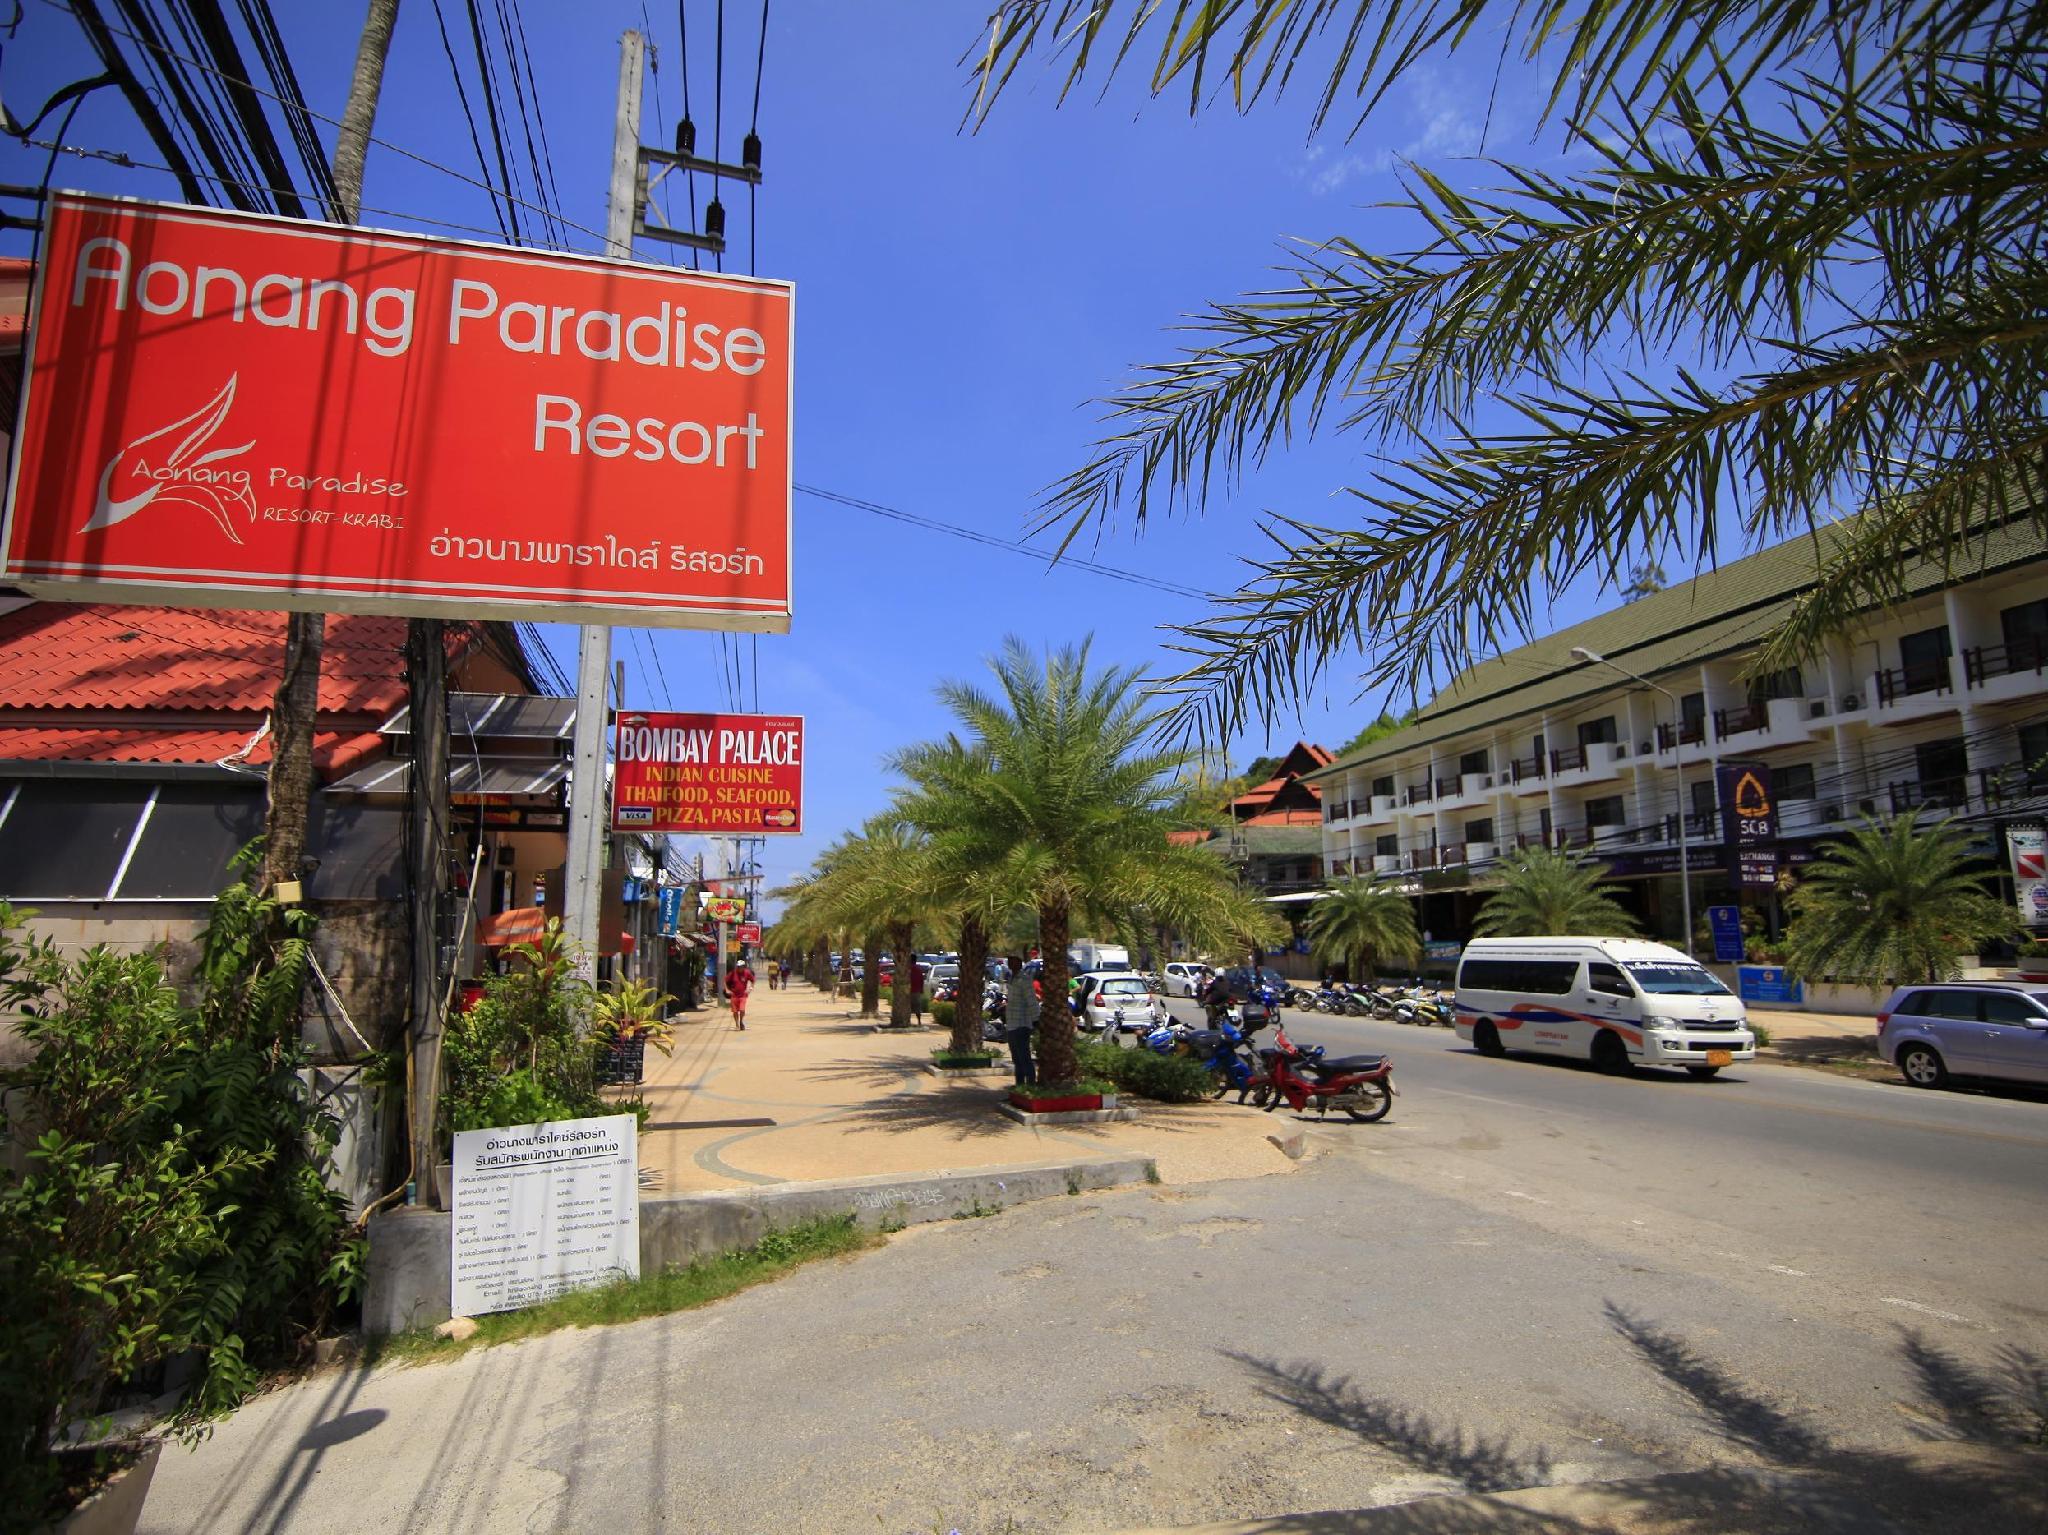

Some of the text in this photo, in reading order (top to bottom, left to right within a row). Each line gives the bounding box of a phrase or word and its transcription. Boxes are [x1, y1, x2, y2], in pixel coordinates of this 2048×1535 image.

[72, 236, 766, 376] Aonang Paradise
[534, 394, 765, 470] Resort
[132, 458, 408, 501] Aonang Paradise
[620, 726, 800, 765] BOMBAY PALACE
[646, 766, 774, 784] INDIAN CUISINE
[625, 785, 795, 807] THAIFOOD, SEAFOOD,
[626, 812, 647, 820] VISA
[657, 807, 762, 825] PIZZA, PASTA
[1740, 820, 1770, 834] SCB
